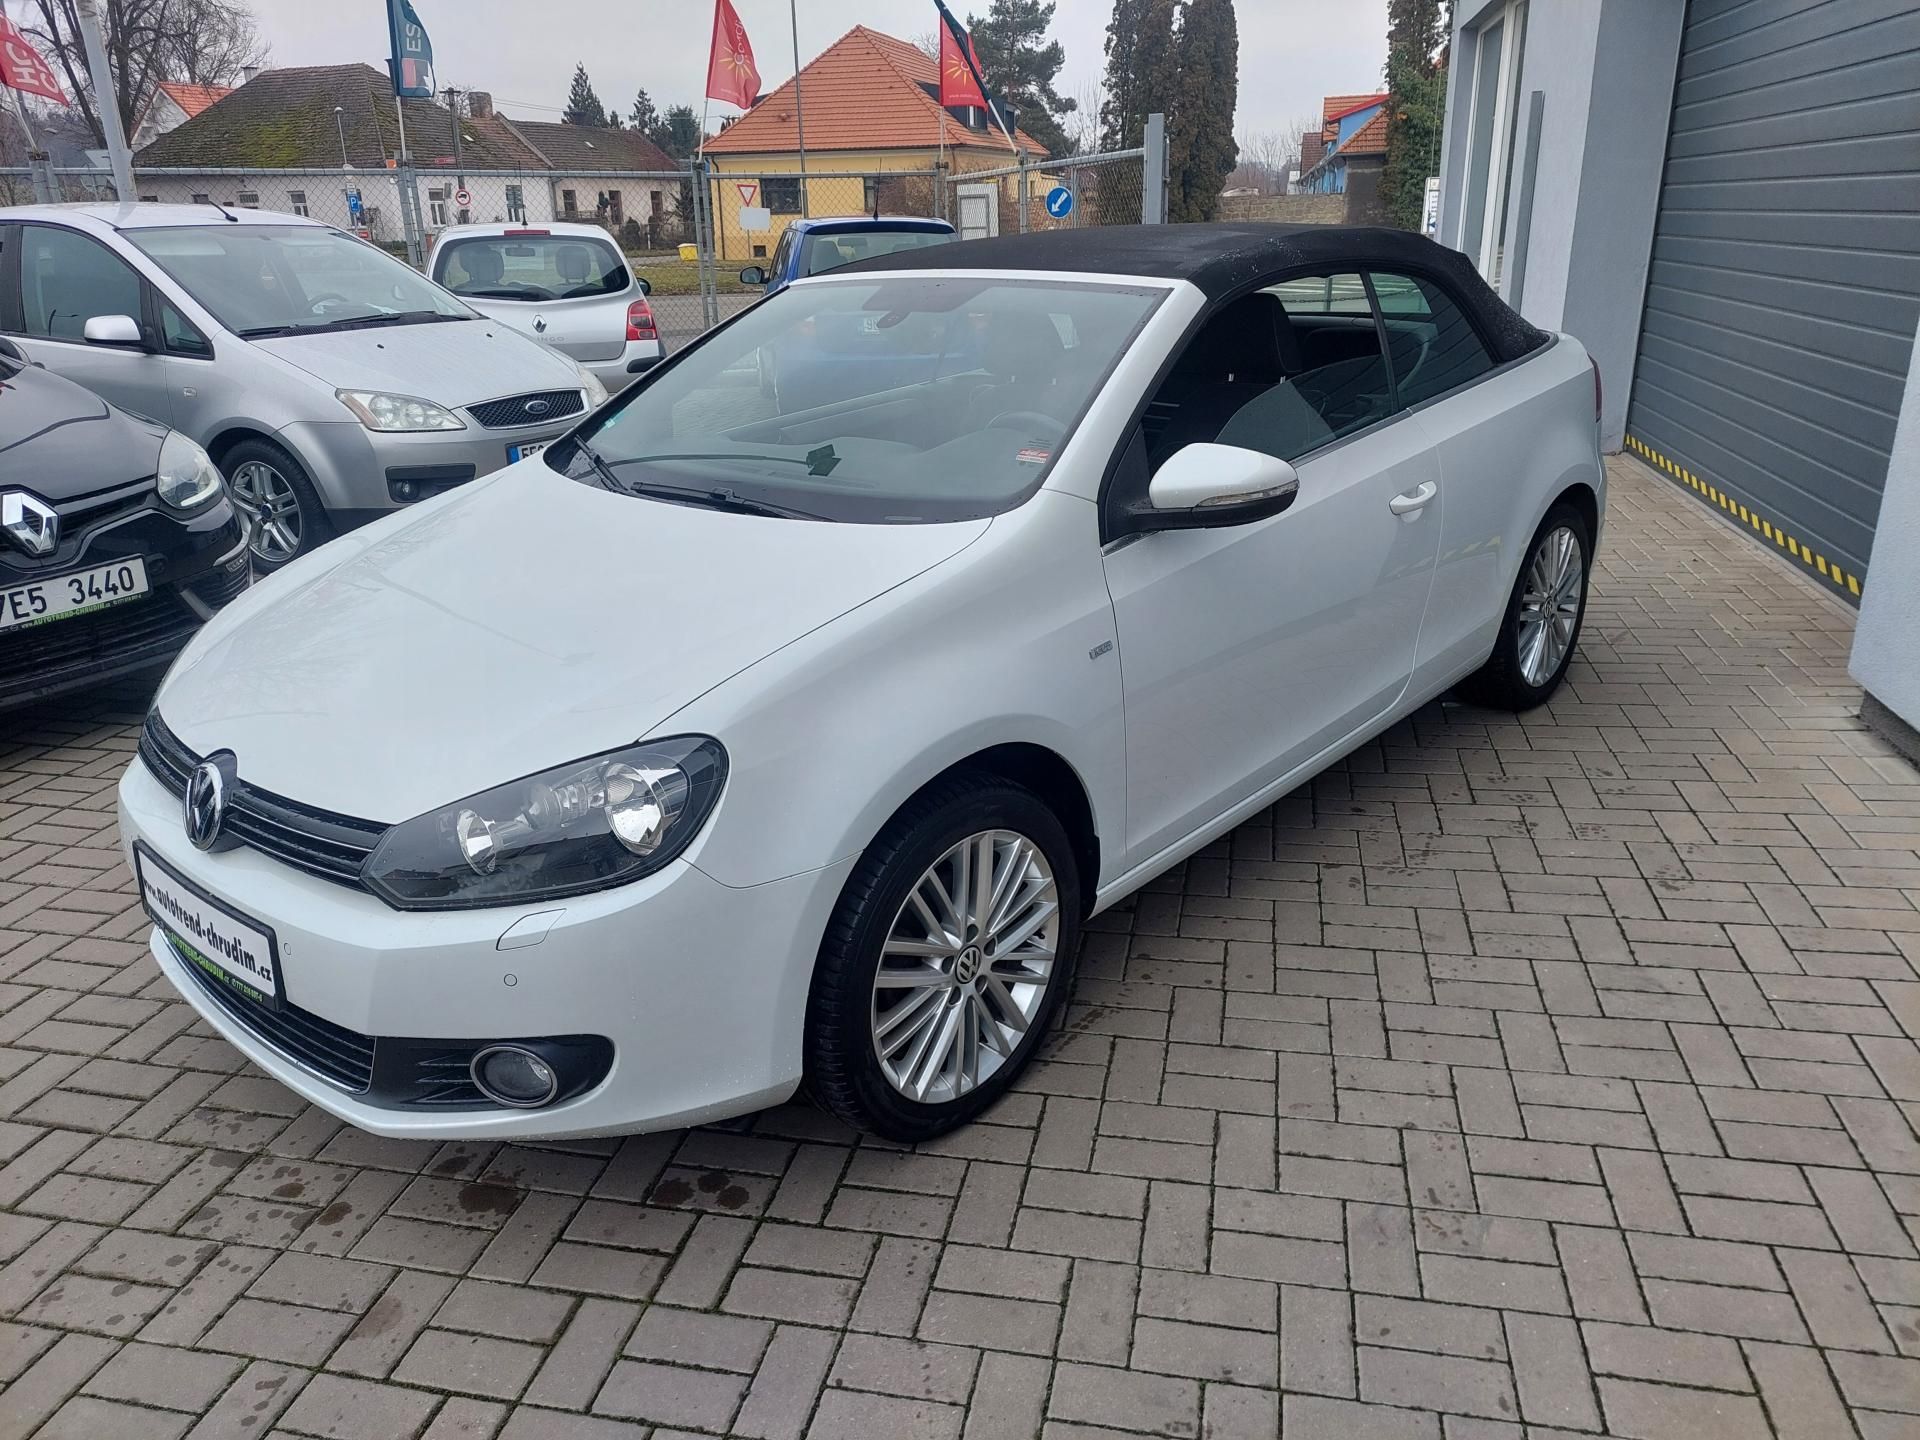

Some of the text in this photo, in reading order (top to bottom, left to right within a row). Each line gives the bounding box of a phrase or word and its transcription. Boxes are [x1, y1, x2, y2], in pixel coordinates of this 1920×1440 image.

[406, 23, 422, 52] ES
[68, 566, 135, 605] 3440
[143, 879, 272, 982] www.autotrend-chrudim.cz
